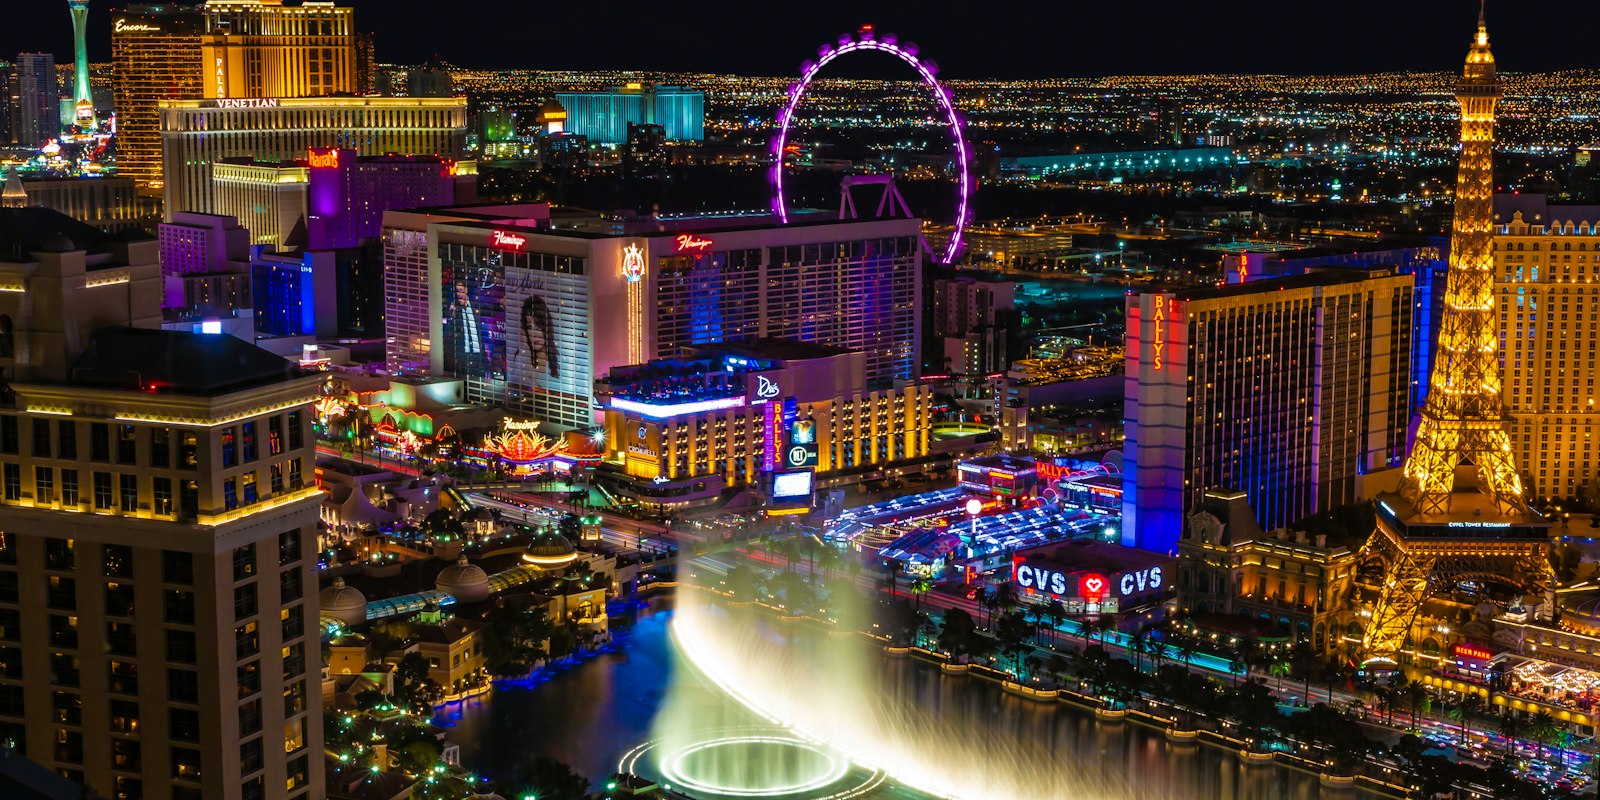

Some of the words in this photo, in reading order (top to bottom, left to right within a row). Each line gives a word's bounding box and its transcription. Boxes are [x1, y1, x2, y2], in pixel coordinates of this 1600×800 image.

[115, 19, 160, 32] Encore
[217, 99, 277, 108] VENETIAN
[494, 231, 525, 249] Flamingo
[677, 235, 712, 250] Flamingo
[1153, 295, 1164, 370] BALLYS
[504, 416, 540, 433] Flamingo
[774, 403, 782, 463] BALLYS
[1017, 565, 1066, 595] CVS
[1120, 566, 1162, 595] CVS
[1456, 646, 1472, 656] BEER
[1473, 650, 1490, 660] PARK
